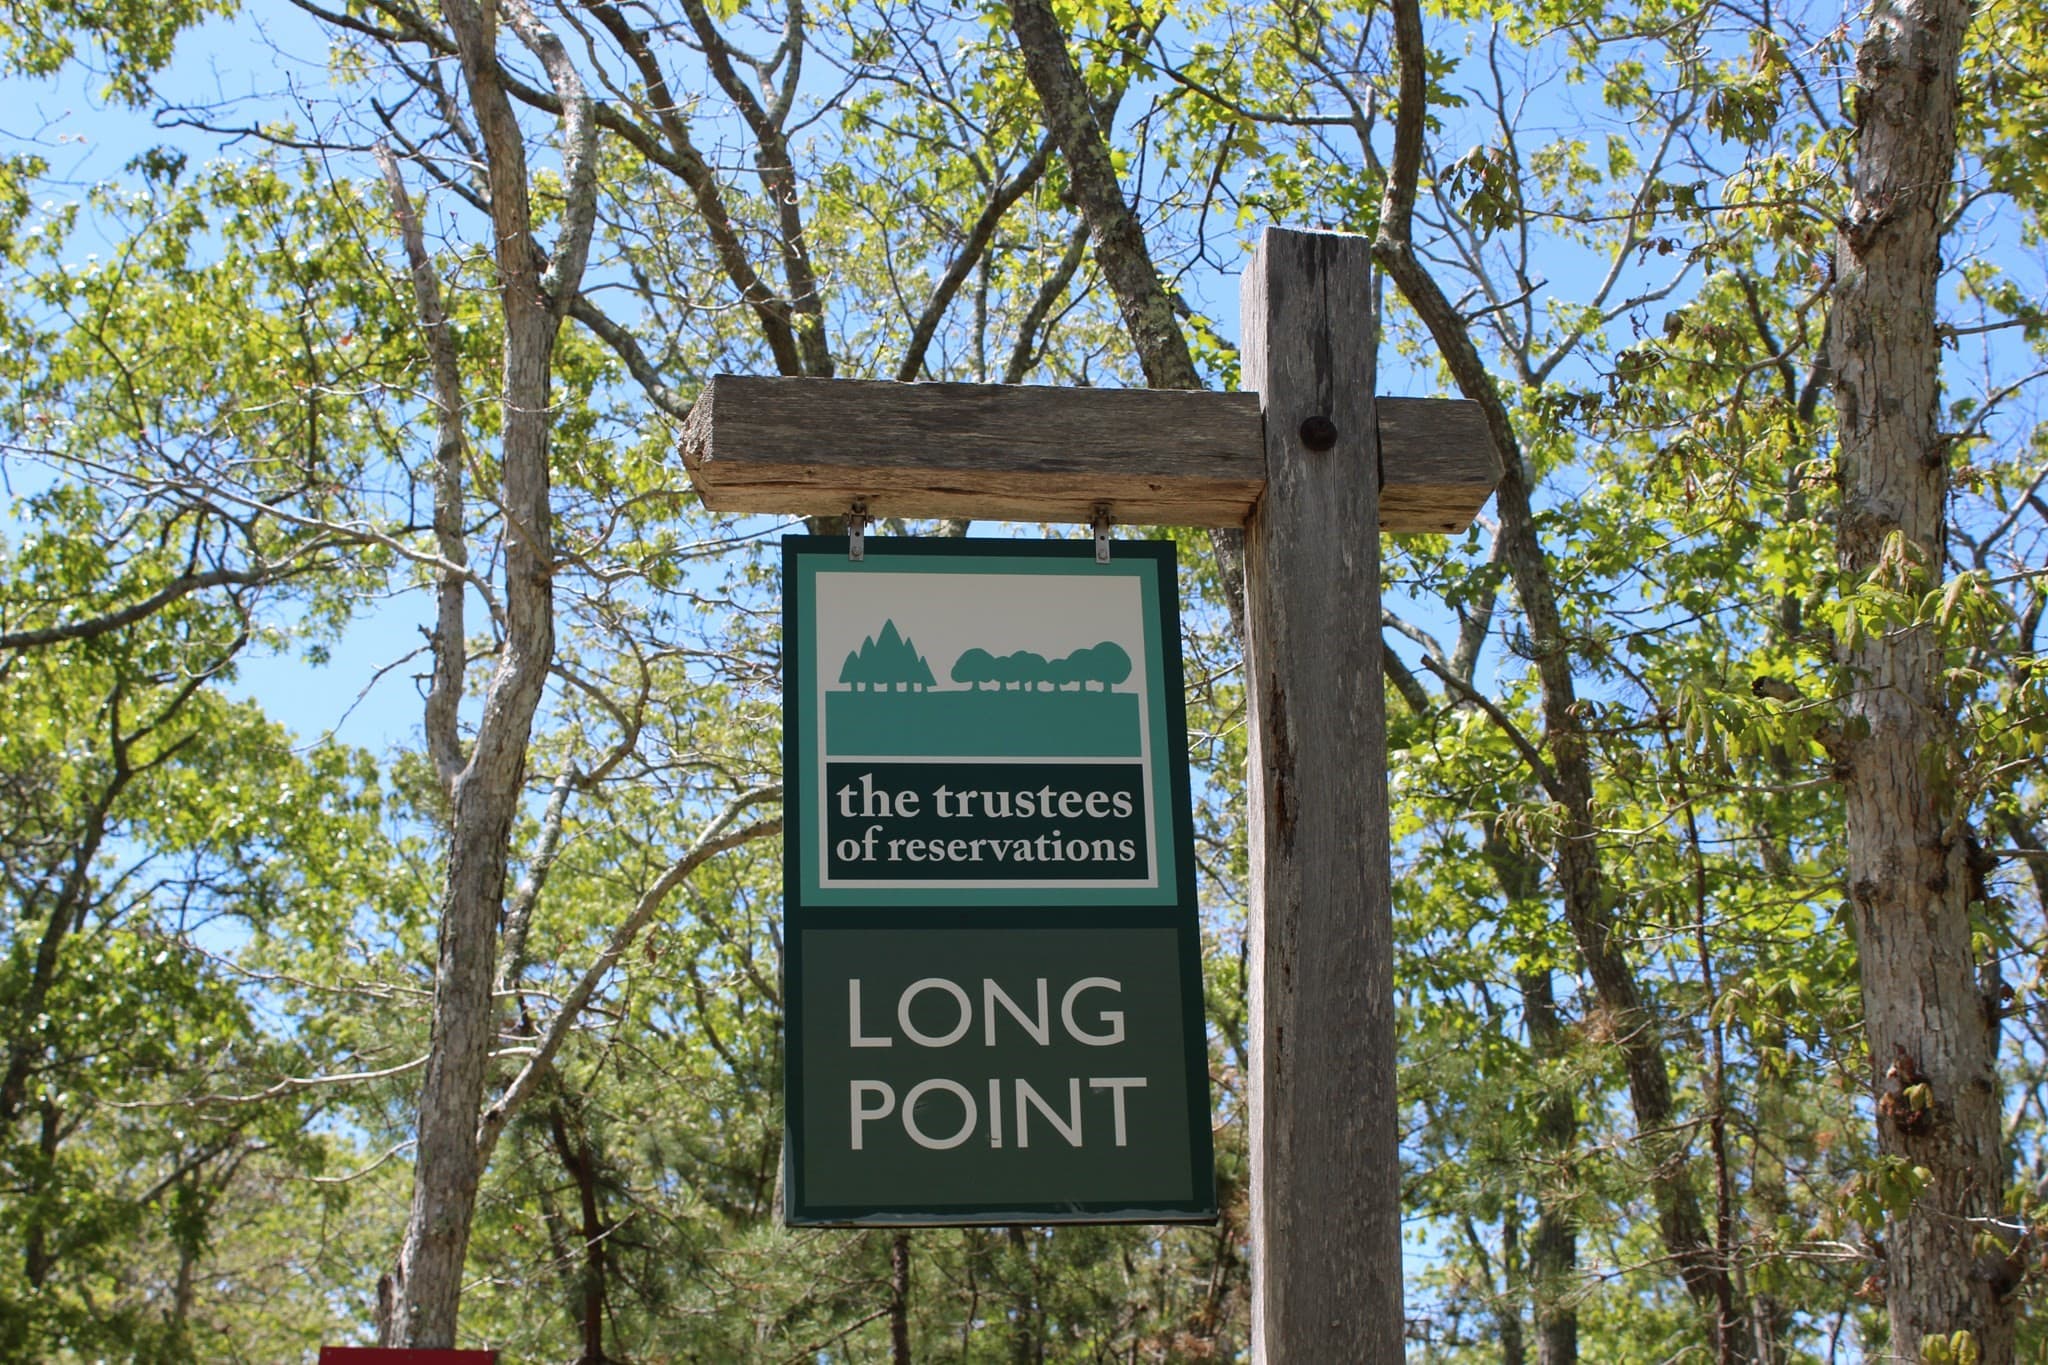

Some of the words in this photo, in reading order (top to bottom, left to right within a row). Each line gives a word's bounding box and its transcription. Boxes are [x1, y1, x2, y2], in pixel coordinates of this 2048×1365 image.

[836, 773, 920, 818] the
[932, 784, 1133, 819] trustees
[836, 825, 883, 862] of
[887, 830, 1136, 862] reservations
[848, 977, 1126, 1048] LONG
[850, 1078, 1147, 1151] POINT
